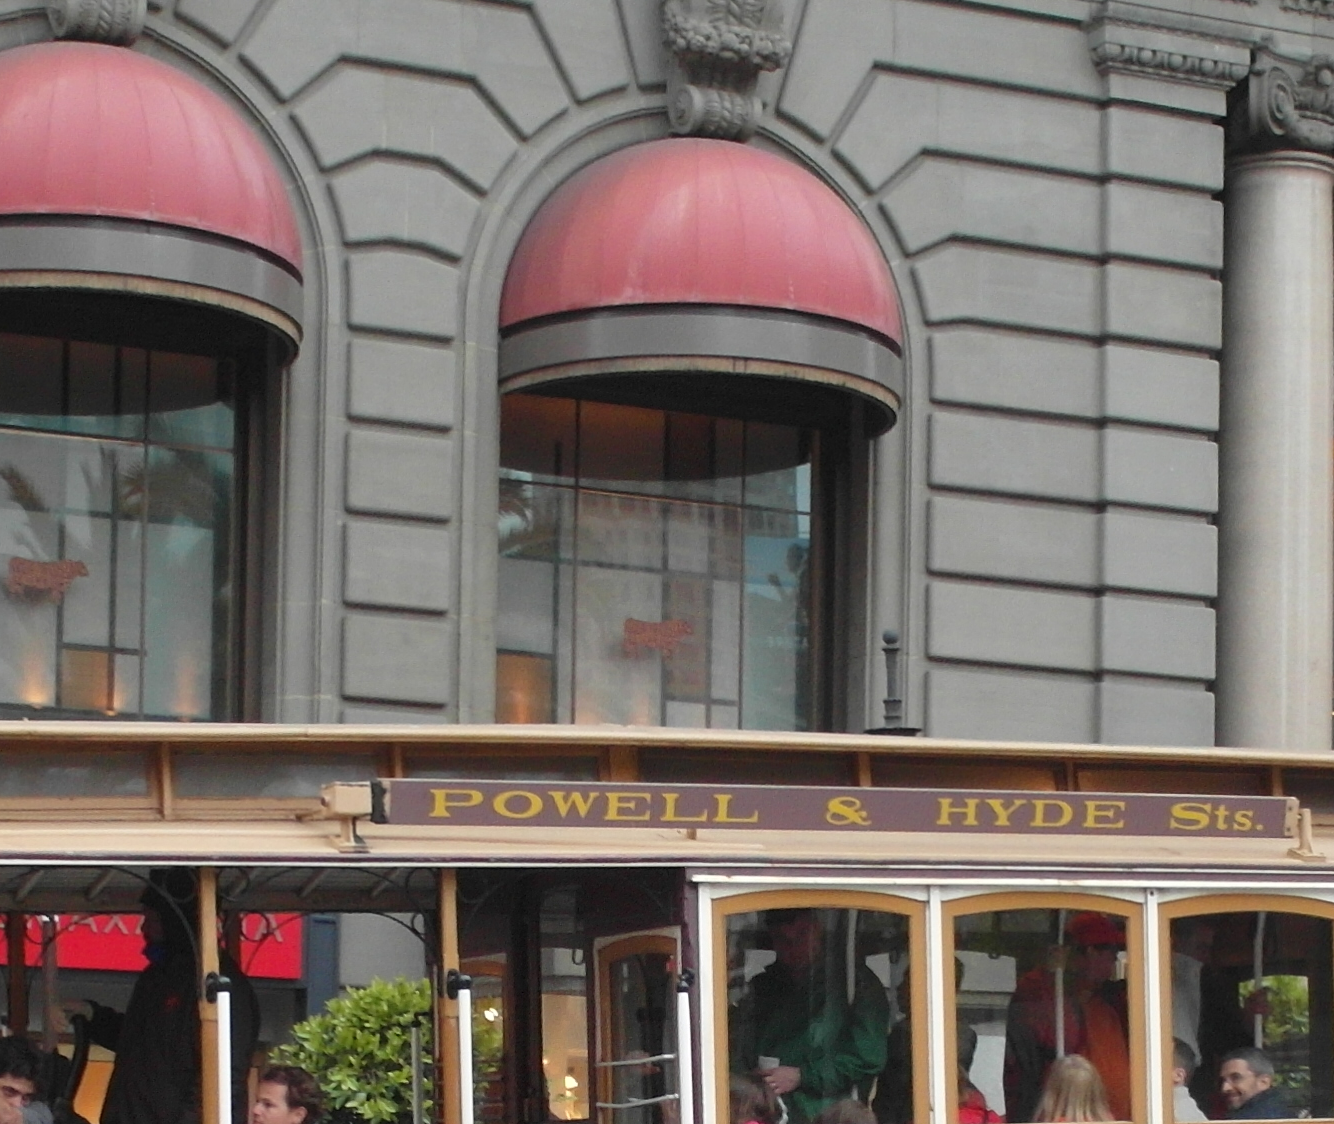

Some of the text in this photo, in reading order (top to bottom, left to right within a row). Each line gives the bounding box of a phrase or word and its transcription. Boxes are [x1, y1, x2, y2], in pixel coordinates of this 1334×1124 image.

[428, 788, 1265, 832] POWELL & HYDE Sts.
